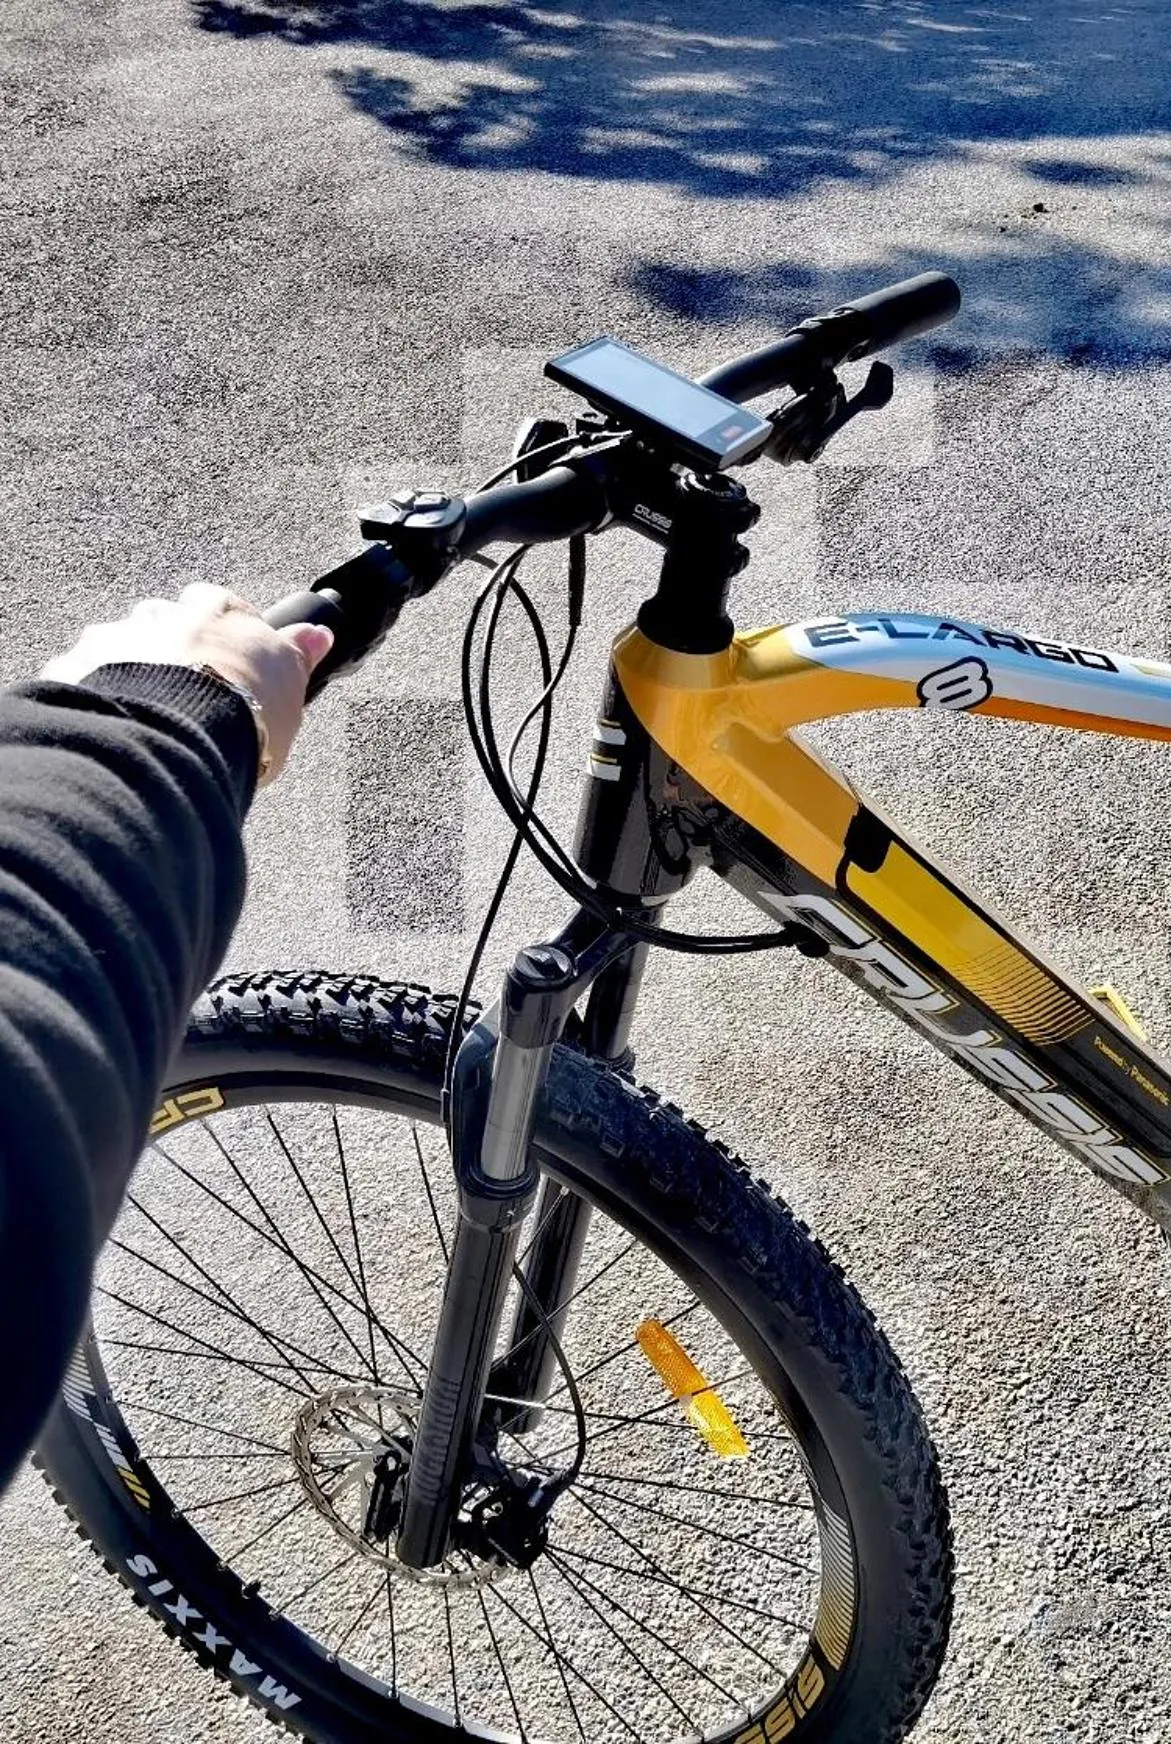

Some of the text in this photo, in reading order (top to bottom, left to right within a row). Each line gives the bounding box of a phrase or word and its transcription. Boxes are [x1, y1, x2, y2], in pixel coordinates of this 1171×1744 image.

[806, 616, 1118, 673] E-LARGO
[757, 891, 1171, 1186] CRUSSIS
[126, 1552, 302, 1711] MAXXIS
